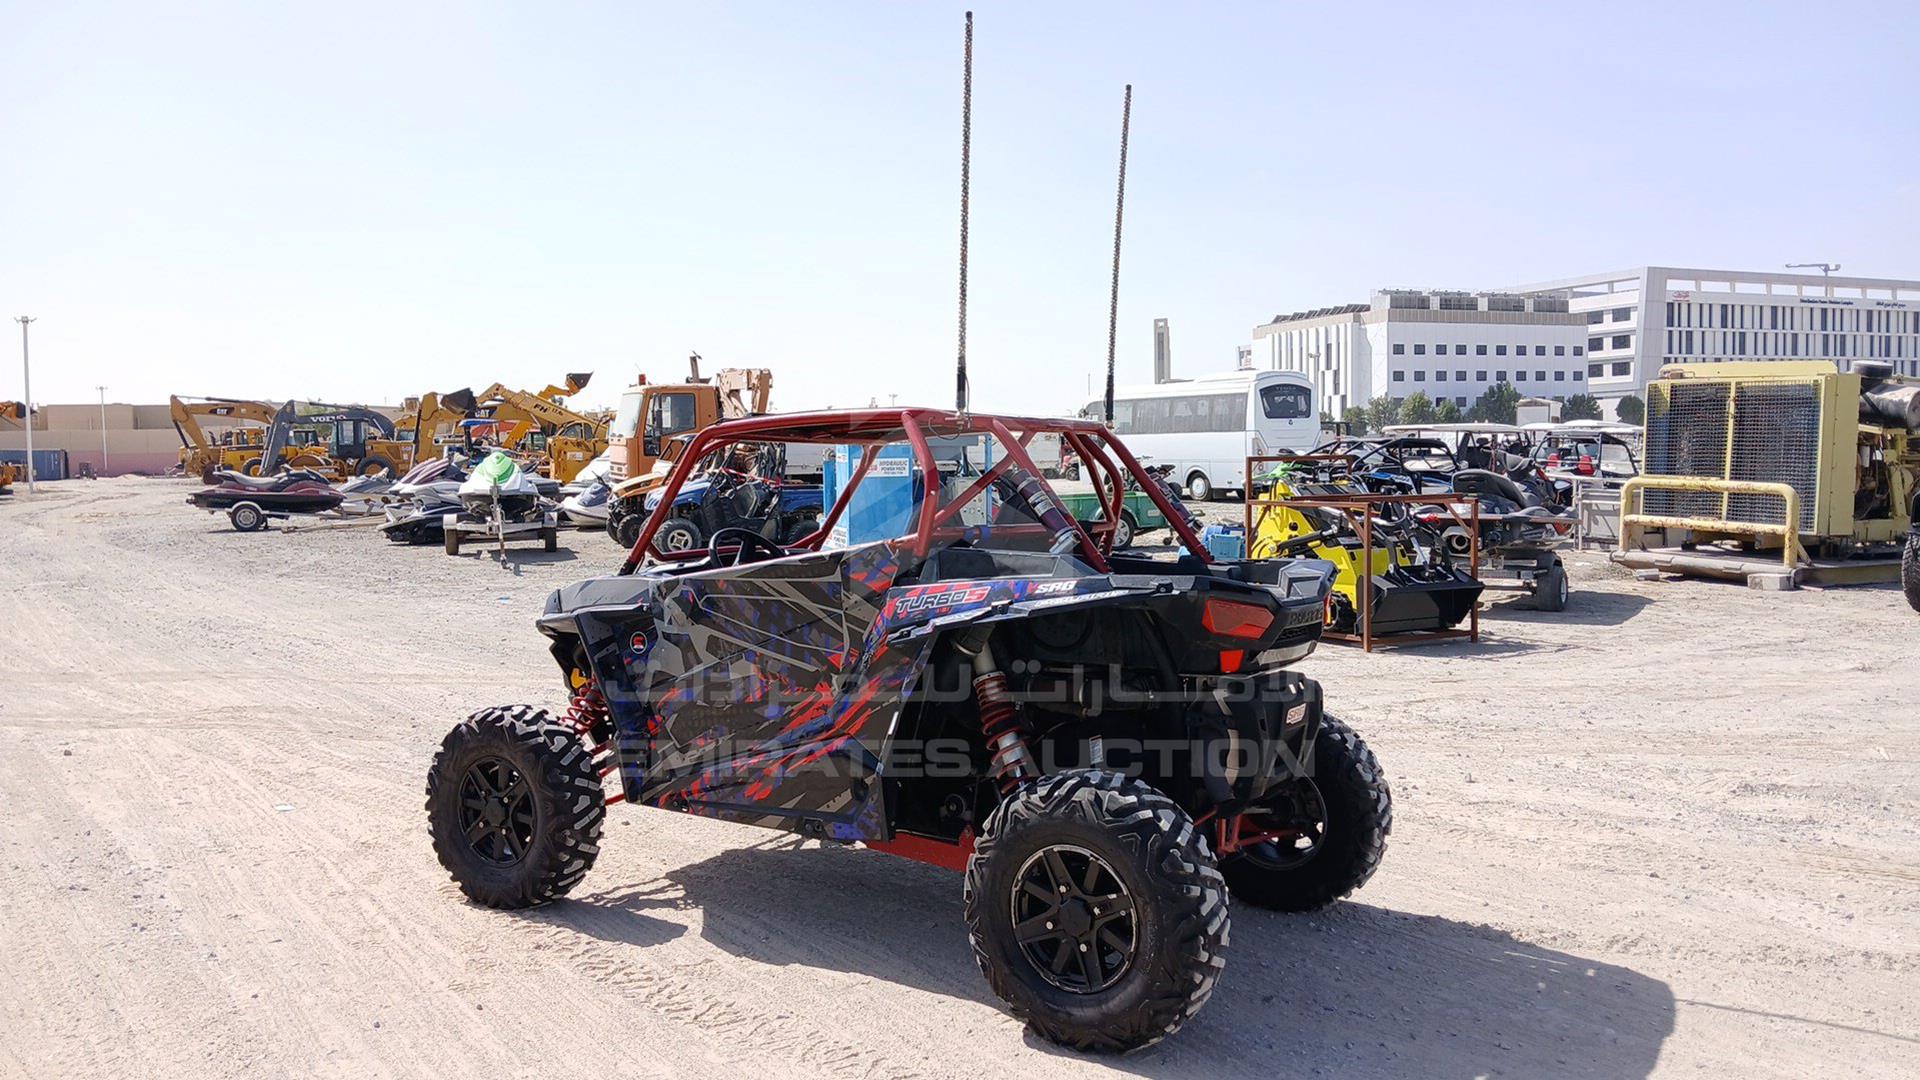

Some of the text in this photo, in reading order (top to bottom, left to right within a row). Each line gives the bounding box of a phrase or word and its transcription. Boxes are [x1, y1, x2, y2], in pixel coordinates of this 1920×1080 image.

[475, 408, 490, 418] CAT
[533, 403, 549, 414] FH
[217, 409, 227, 419] CAT
[310, 414, 347, 423] VOLVO
